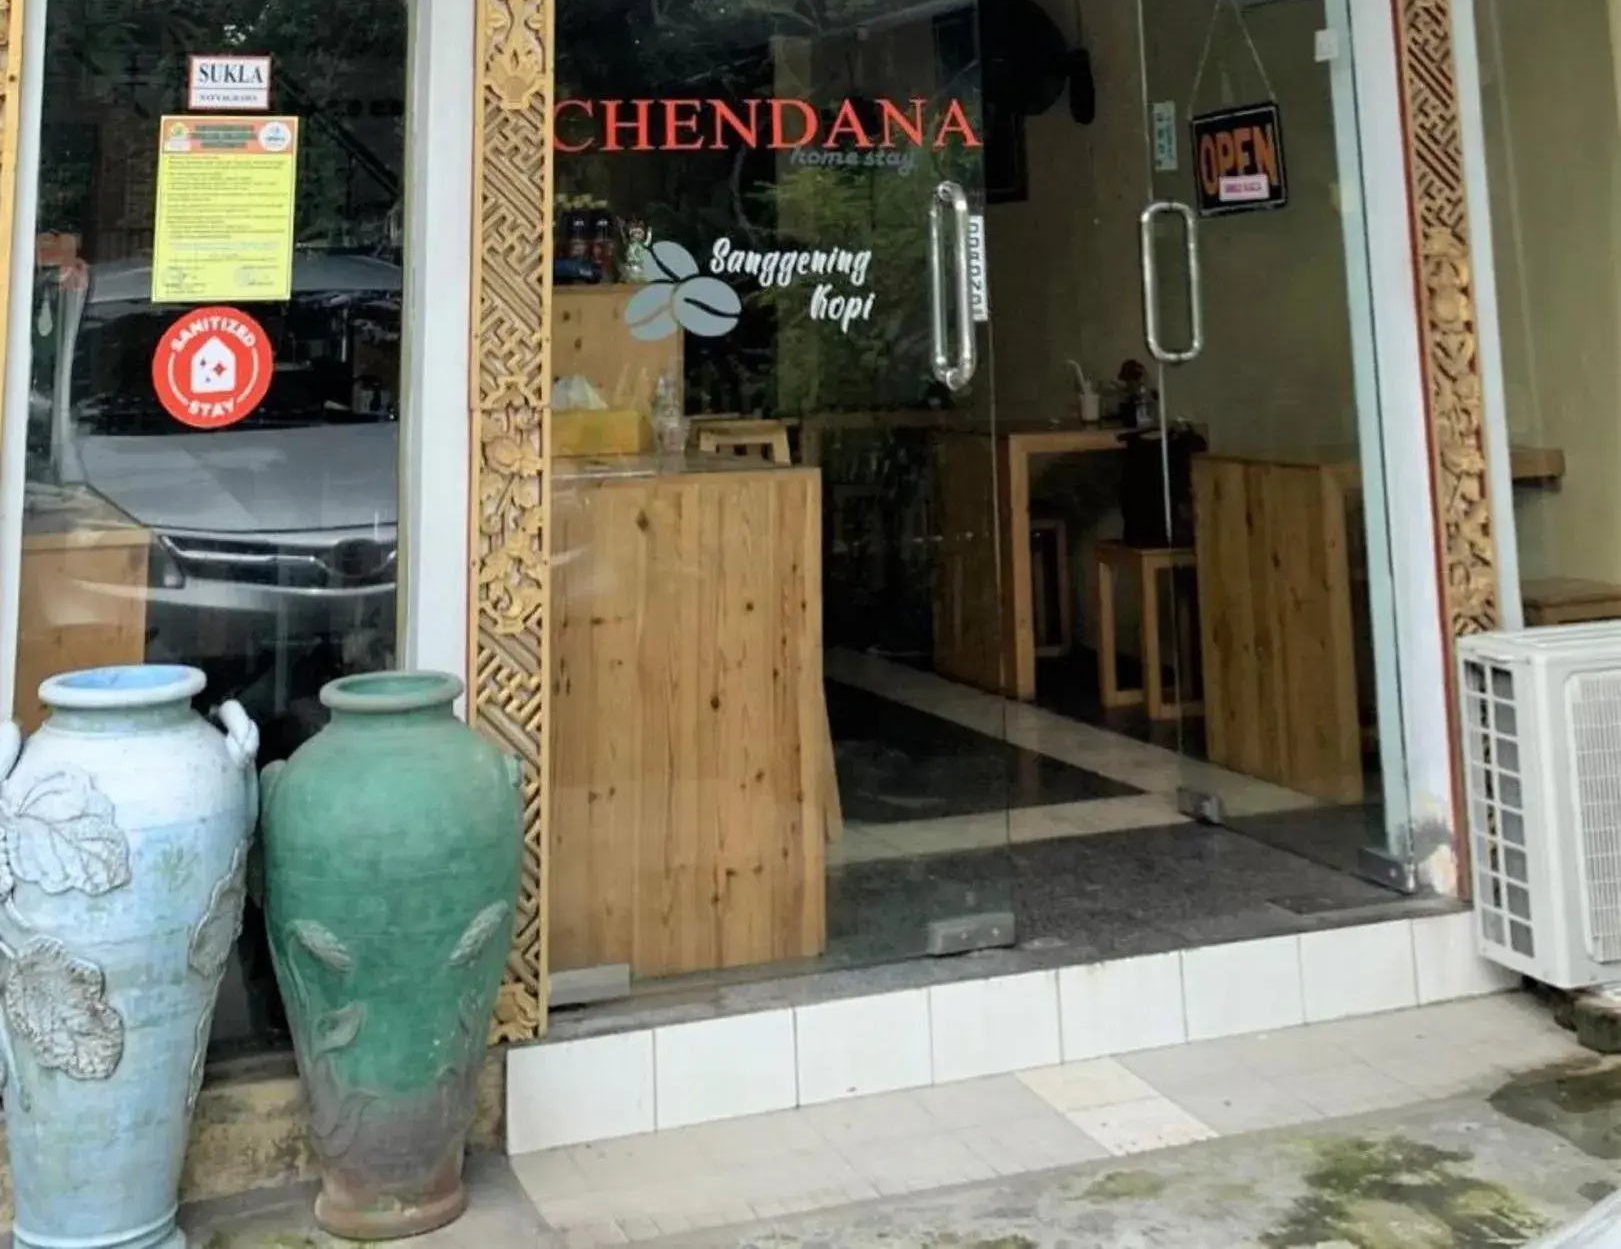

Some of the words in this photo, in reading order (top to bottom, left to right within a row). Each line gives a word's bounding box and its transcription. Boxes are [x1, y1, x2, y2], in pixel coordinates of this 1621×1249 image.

[198, 62, 263, 83] SUKLA
[552, 98, 983, 151] CHENDANA
[1200, 123, 1279, 196] OPEN
[709, 236, 873, 287] Sanggening
[170, 315, 257, 354] SANITIZED
[810, 283, 876, 335] Kopi
[187, 396, 236, 419] STAY
